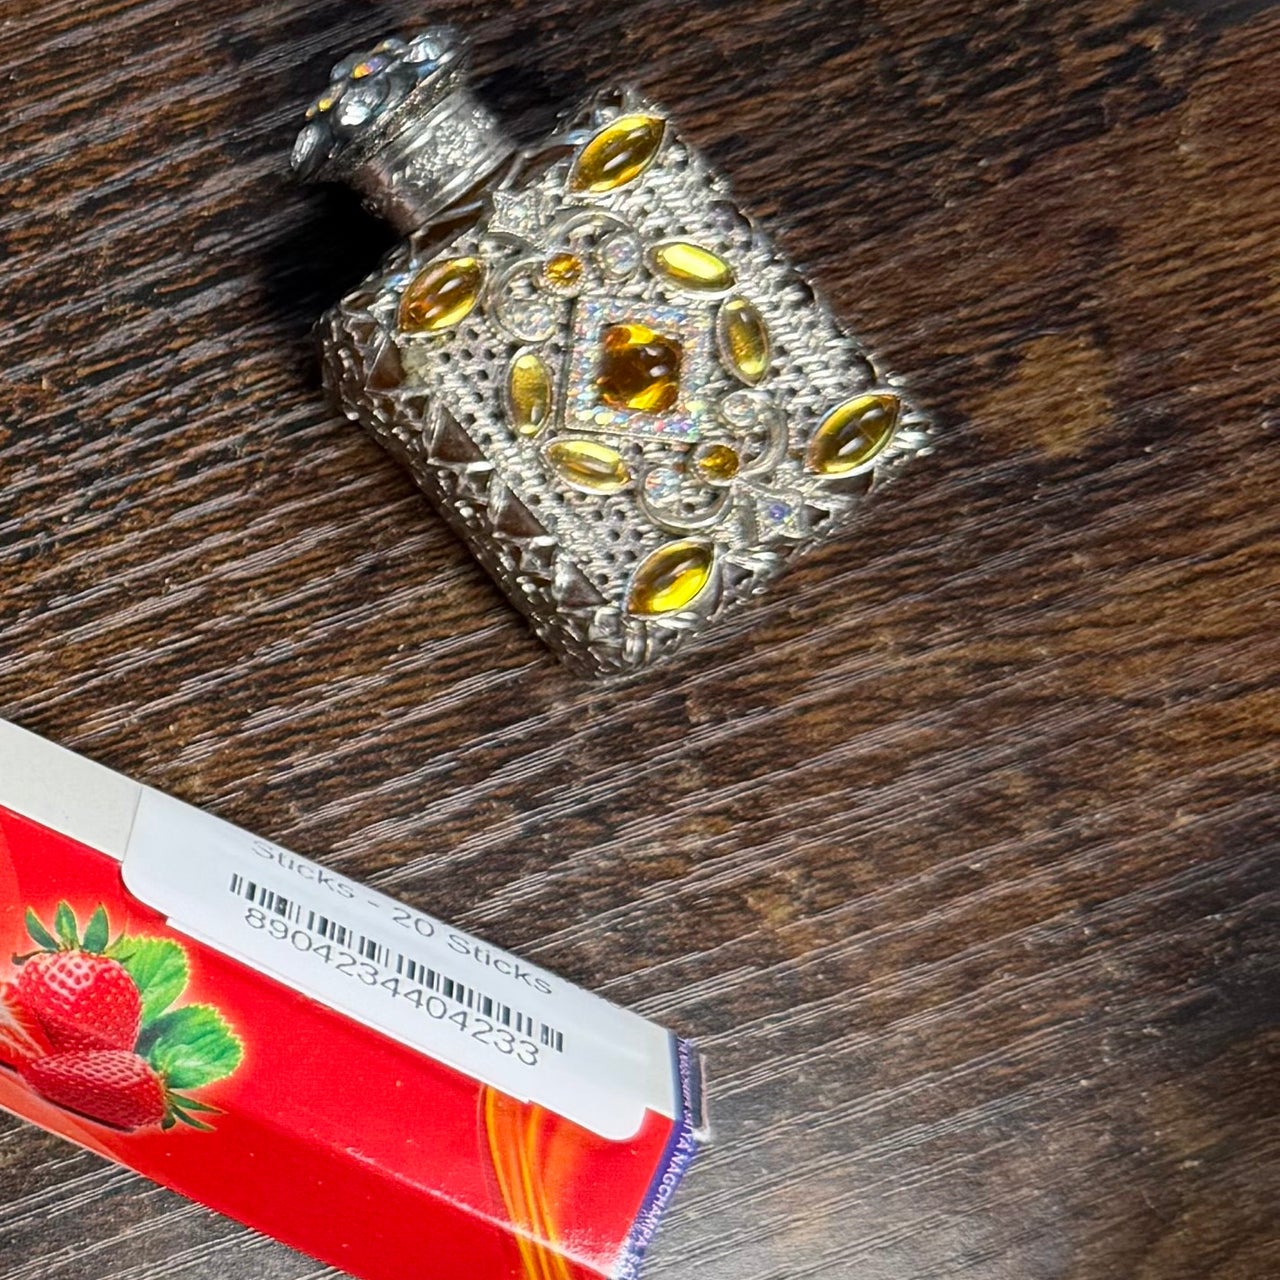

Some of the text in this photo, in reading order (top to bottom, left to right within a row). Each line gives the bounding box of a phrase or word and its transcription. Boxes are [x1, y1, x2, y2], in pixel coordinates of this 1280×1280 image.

[243, 907, 540, 1068] 8904234404233
[249, 839, 356, 900] Sticks
[390, 906, 436, 939] 20
[446, 932, 555, 996] Sticks
[635, 1150, 690, 1249] NAGCHAMPA
